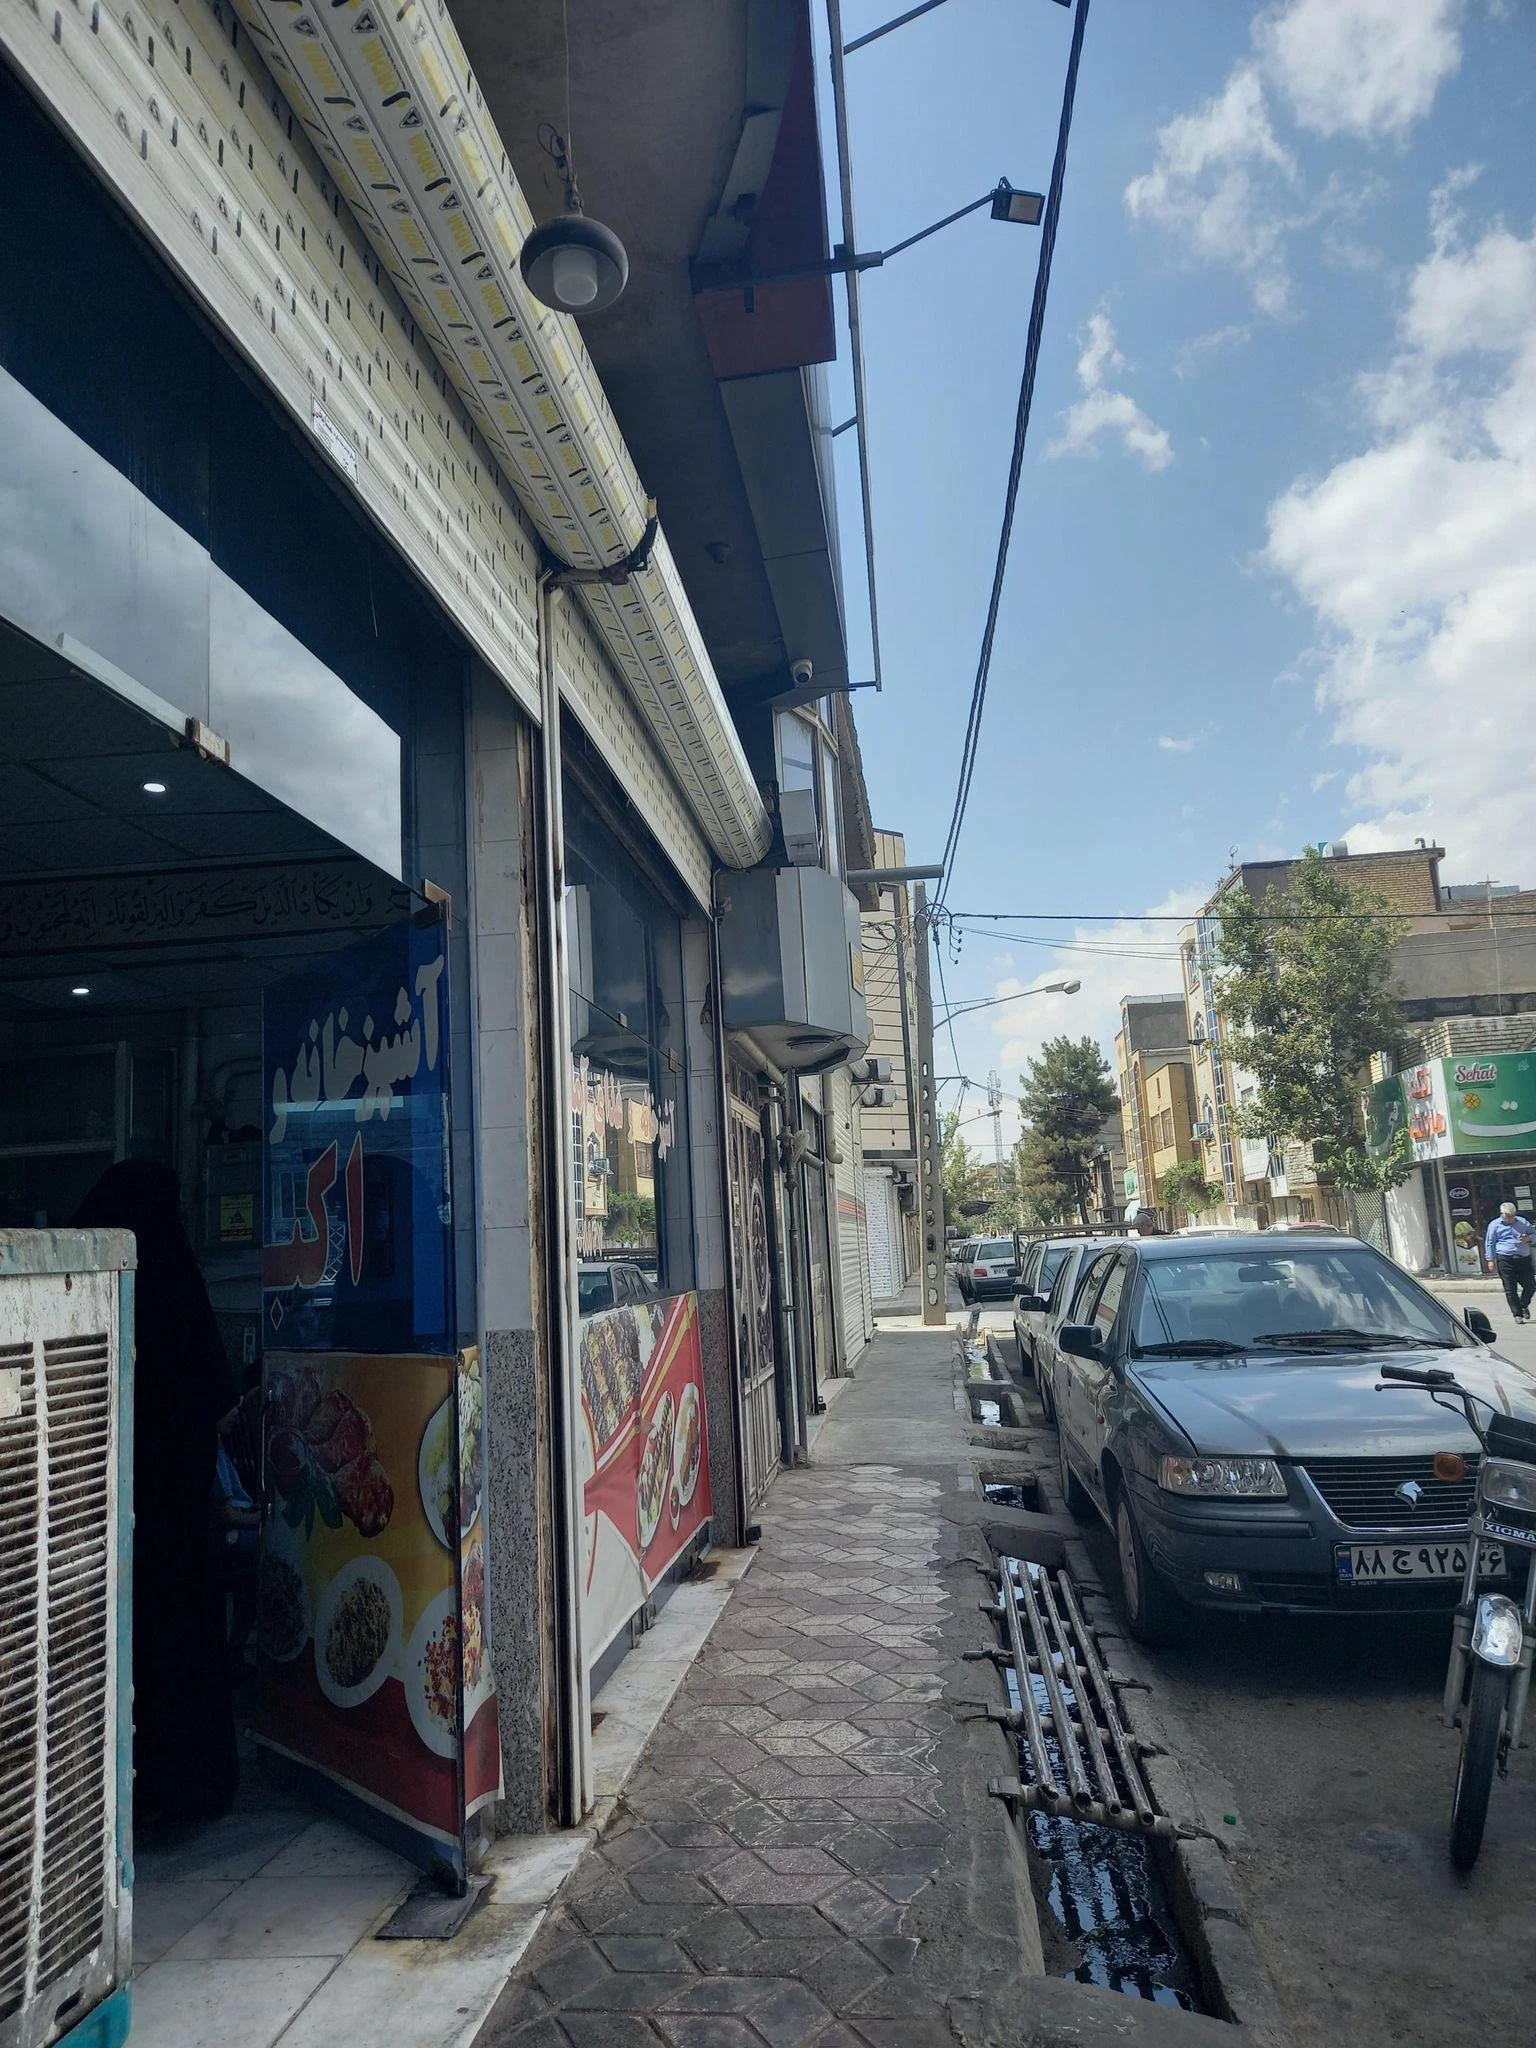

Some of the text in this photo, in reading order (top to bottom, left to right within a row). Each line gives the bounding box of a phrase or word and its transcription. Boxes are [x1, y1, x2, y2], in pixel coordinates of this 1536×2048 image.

[291, 953, 445, 1123] آشپزخانه
[1456, 1063, 1497, 1083] Sehat
[1355, 1549, 1386, 1575] ۸۸
[1392, 1549, 1413, 1575] ج
[1418, 1547, 1467, 1574] ۹۲۵
